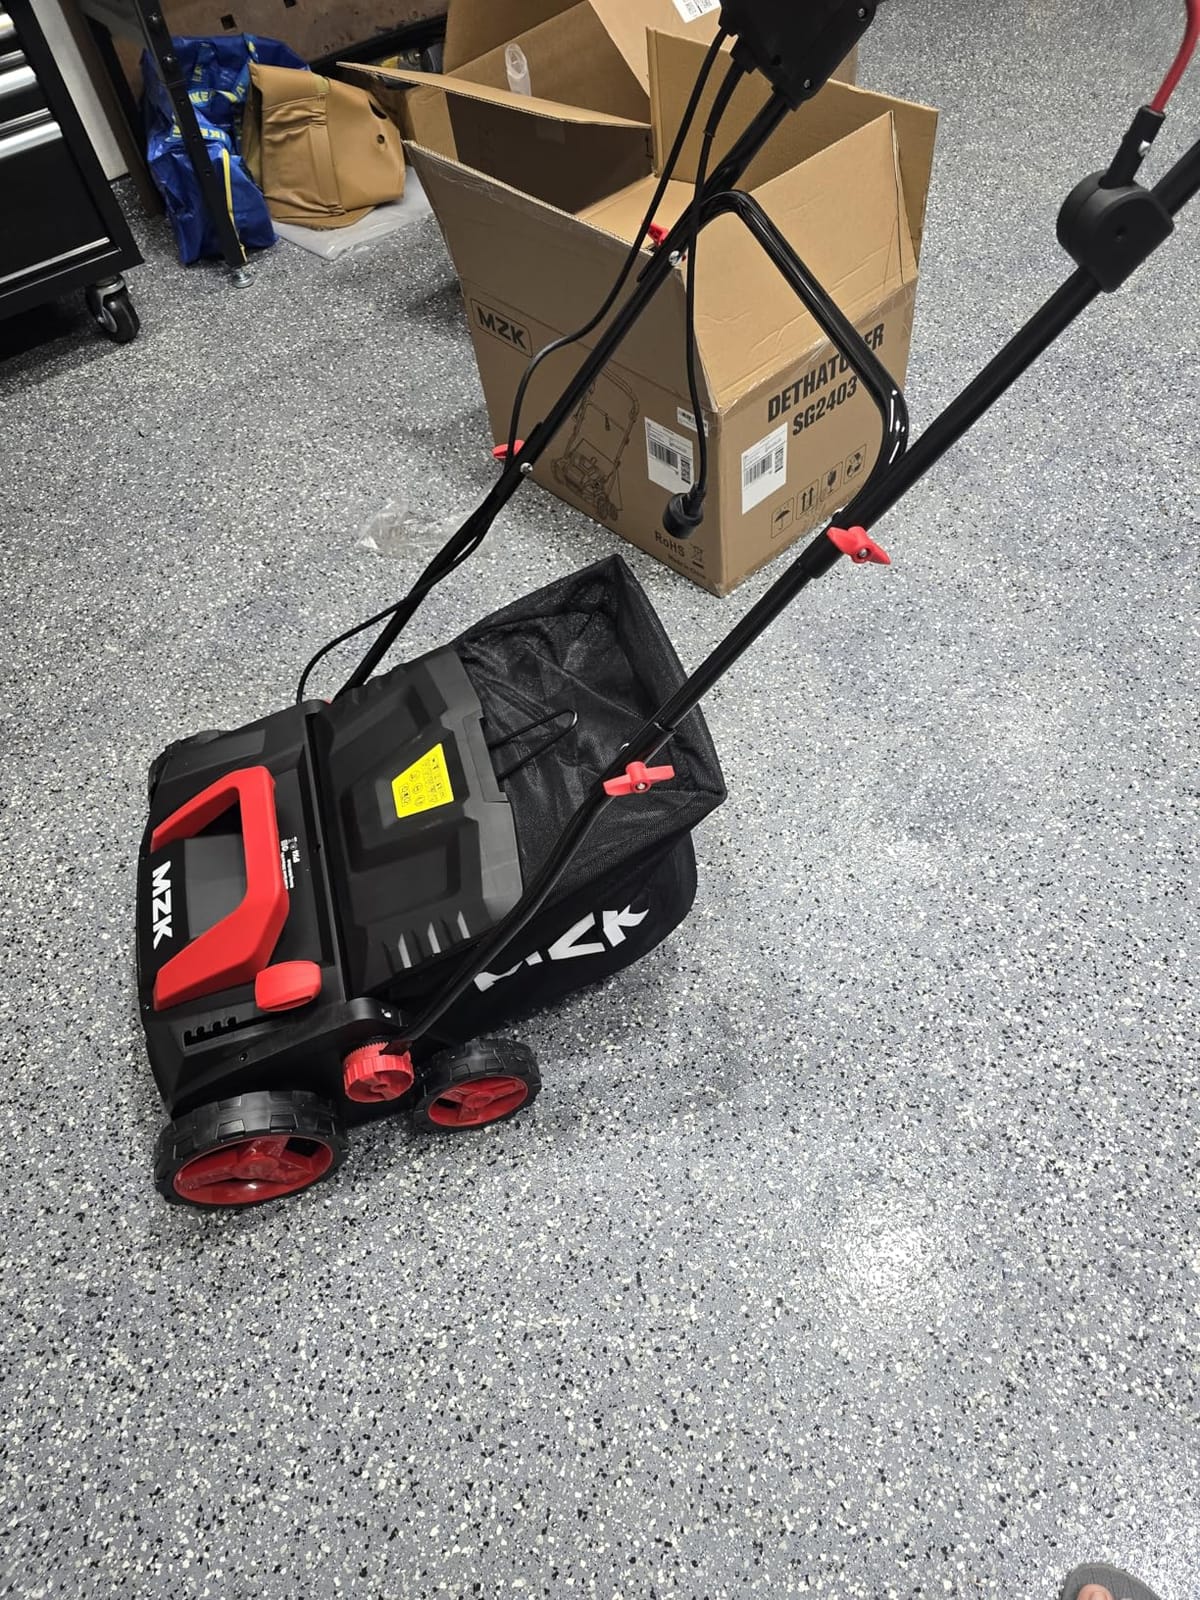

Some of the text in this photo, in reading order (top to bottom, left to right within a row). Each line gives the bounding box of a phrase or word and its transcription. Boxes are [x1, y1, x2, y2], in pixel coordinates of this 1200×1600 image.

[477, 306, 527, 350] MZK
[792, 375, 857, 436] SG2403
[654, 530, 685, 557] RoHS
[151, 860, 173, 950] MZK
